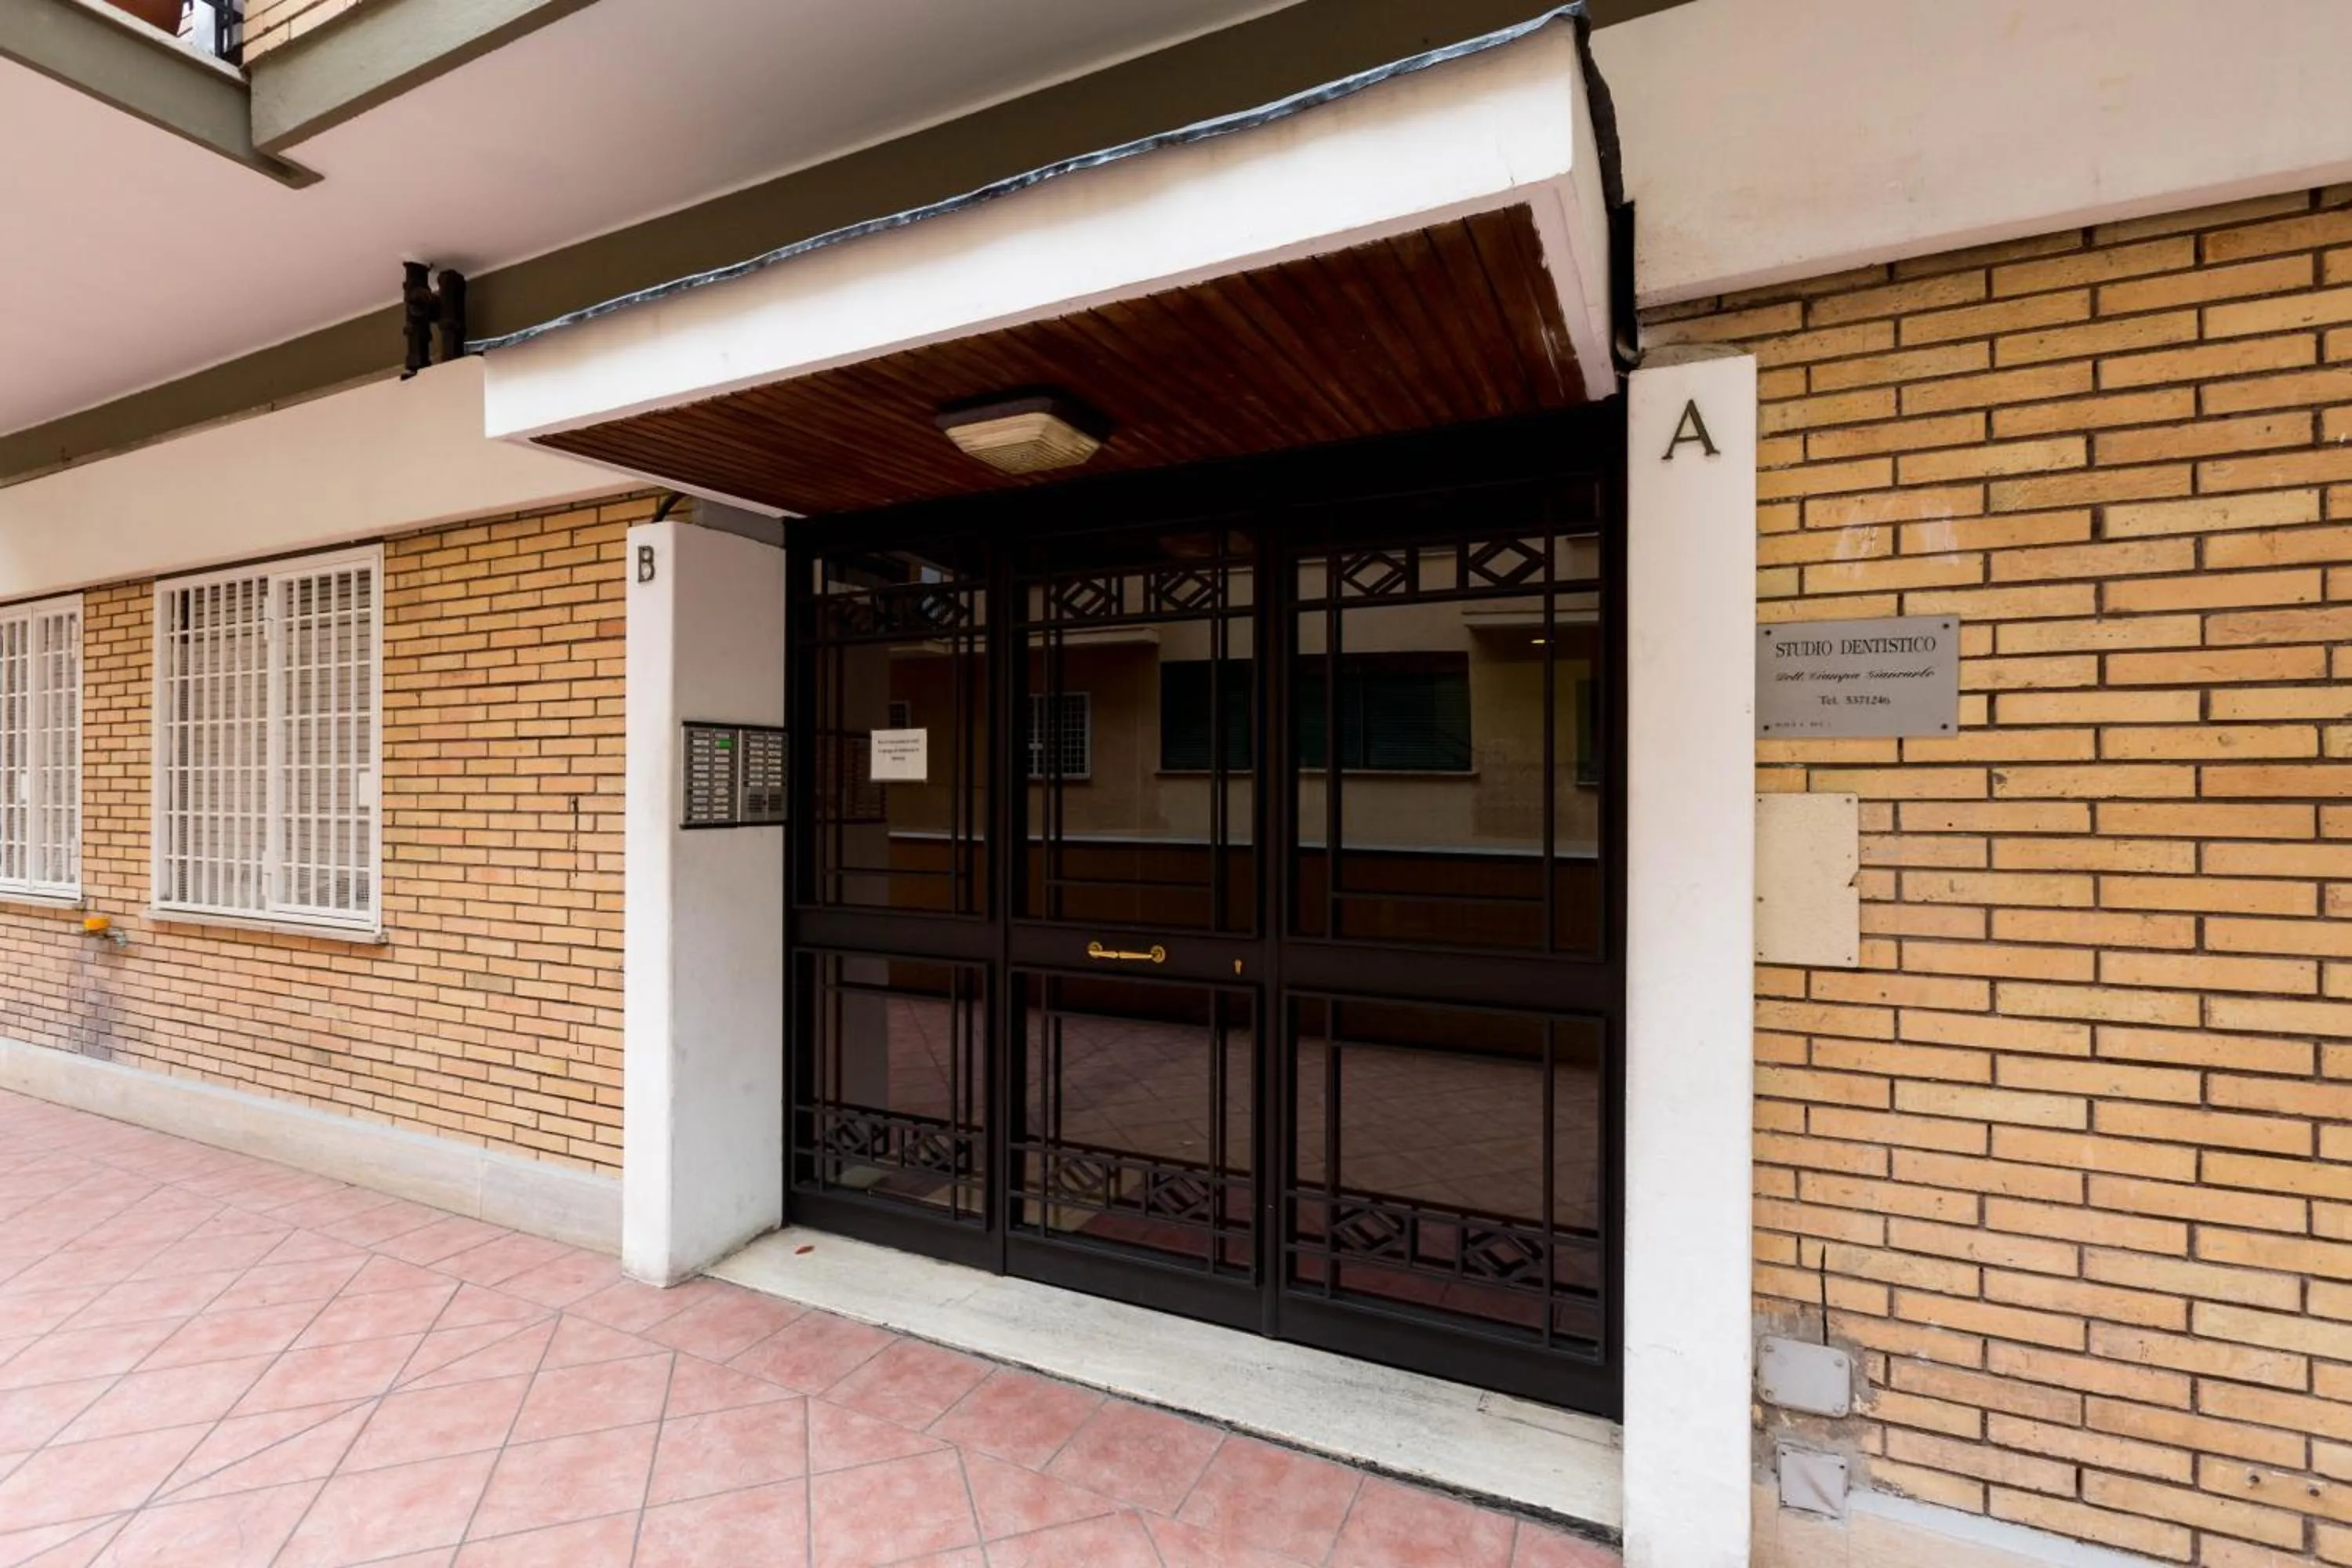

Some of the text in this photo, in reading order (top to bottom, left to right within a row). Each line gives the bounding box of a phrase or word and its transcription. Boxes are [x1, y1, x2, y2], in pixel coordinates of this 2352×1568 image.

[1661, 398, 1721, 461] A
[637, 545, 655, 583] B
[1775, 636, 1936, 659] STUDIO DENTISTICO
